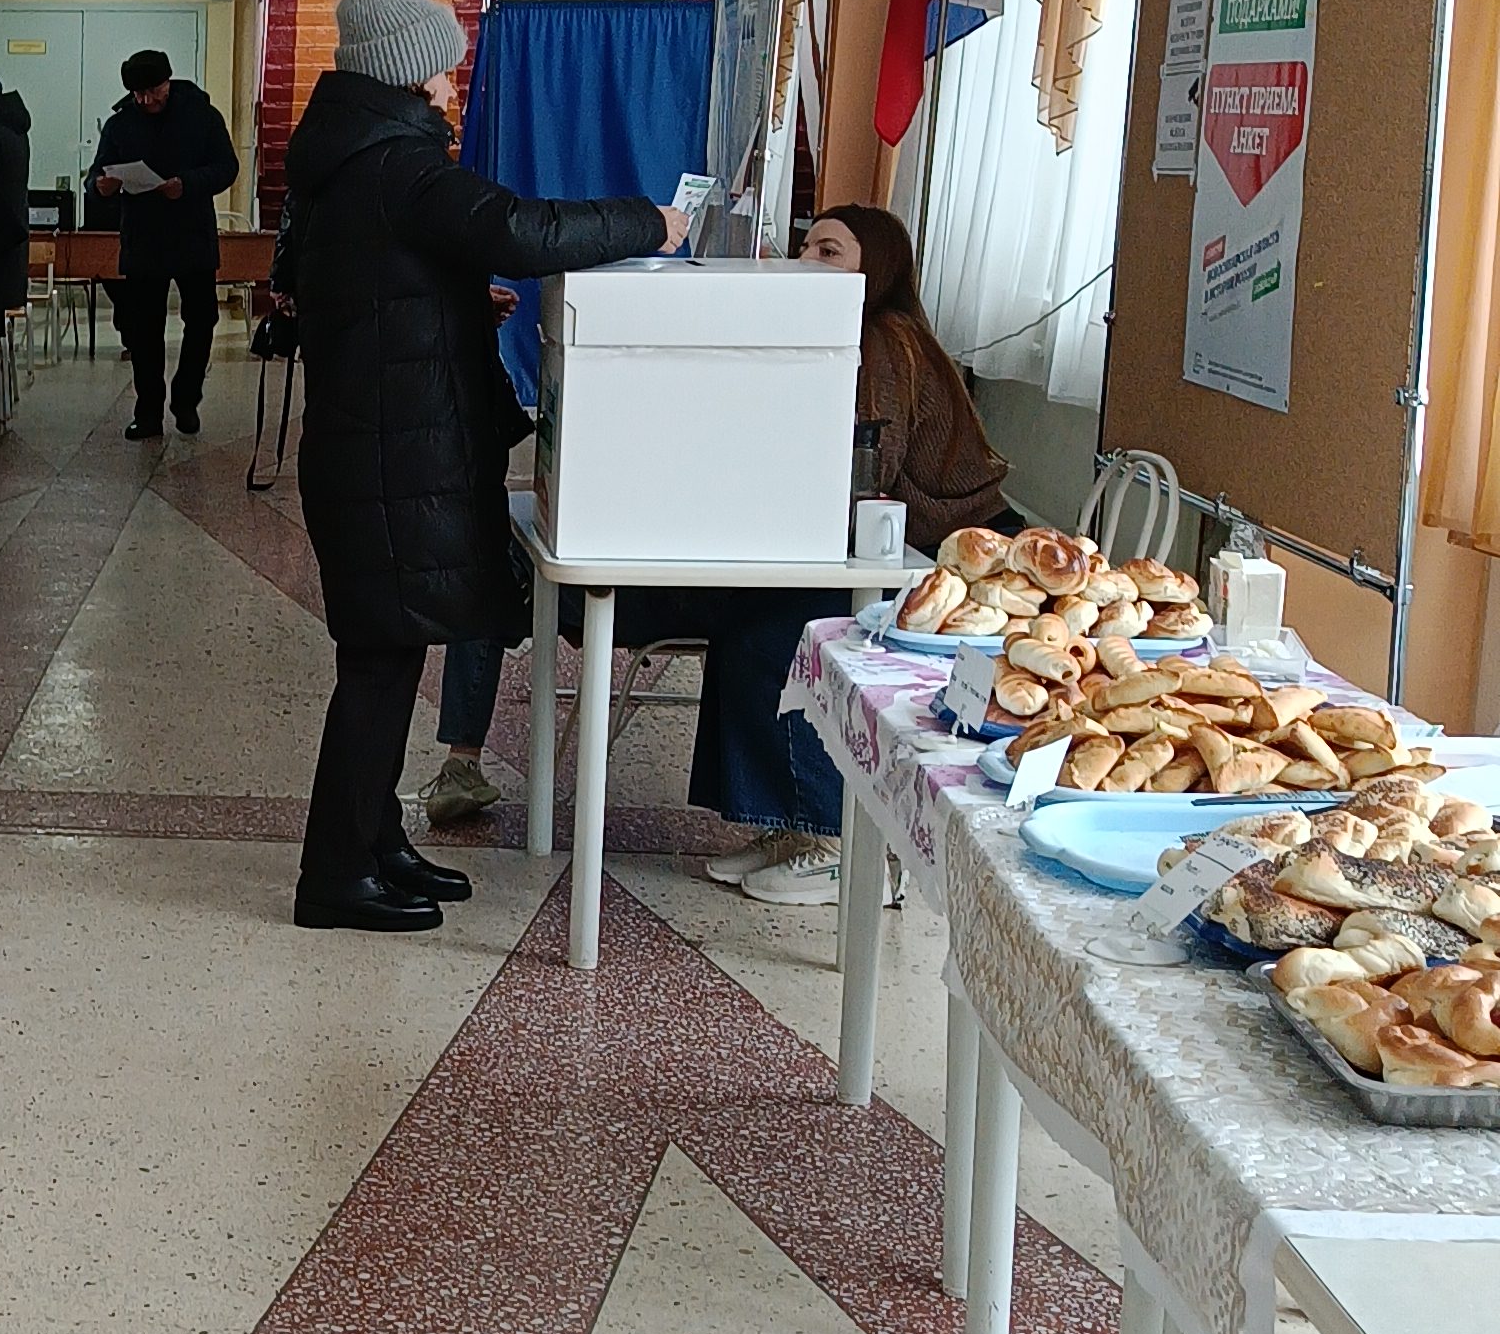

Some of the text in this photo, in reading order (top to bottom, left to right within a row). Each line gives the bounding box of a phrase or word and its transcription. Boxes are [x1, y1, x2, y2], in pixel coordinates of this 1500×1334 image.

[1210, 87, 1299, 115] ПУНКТ ПРИЕМА
[1230, 126, 1269, 155] АНКЕТ
